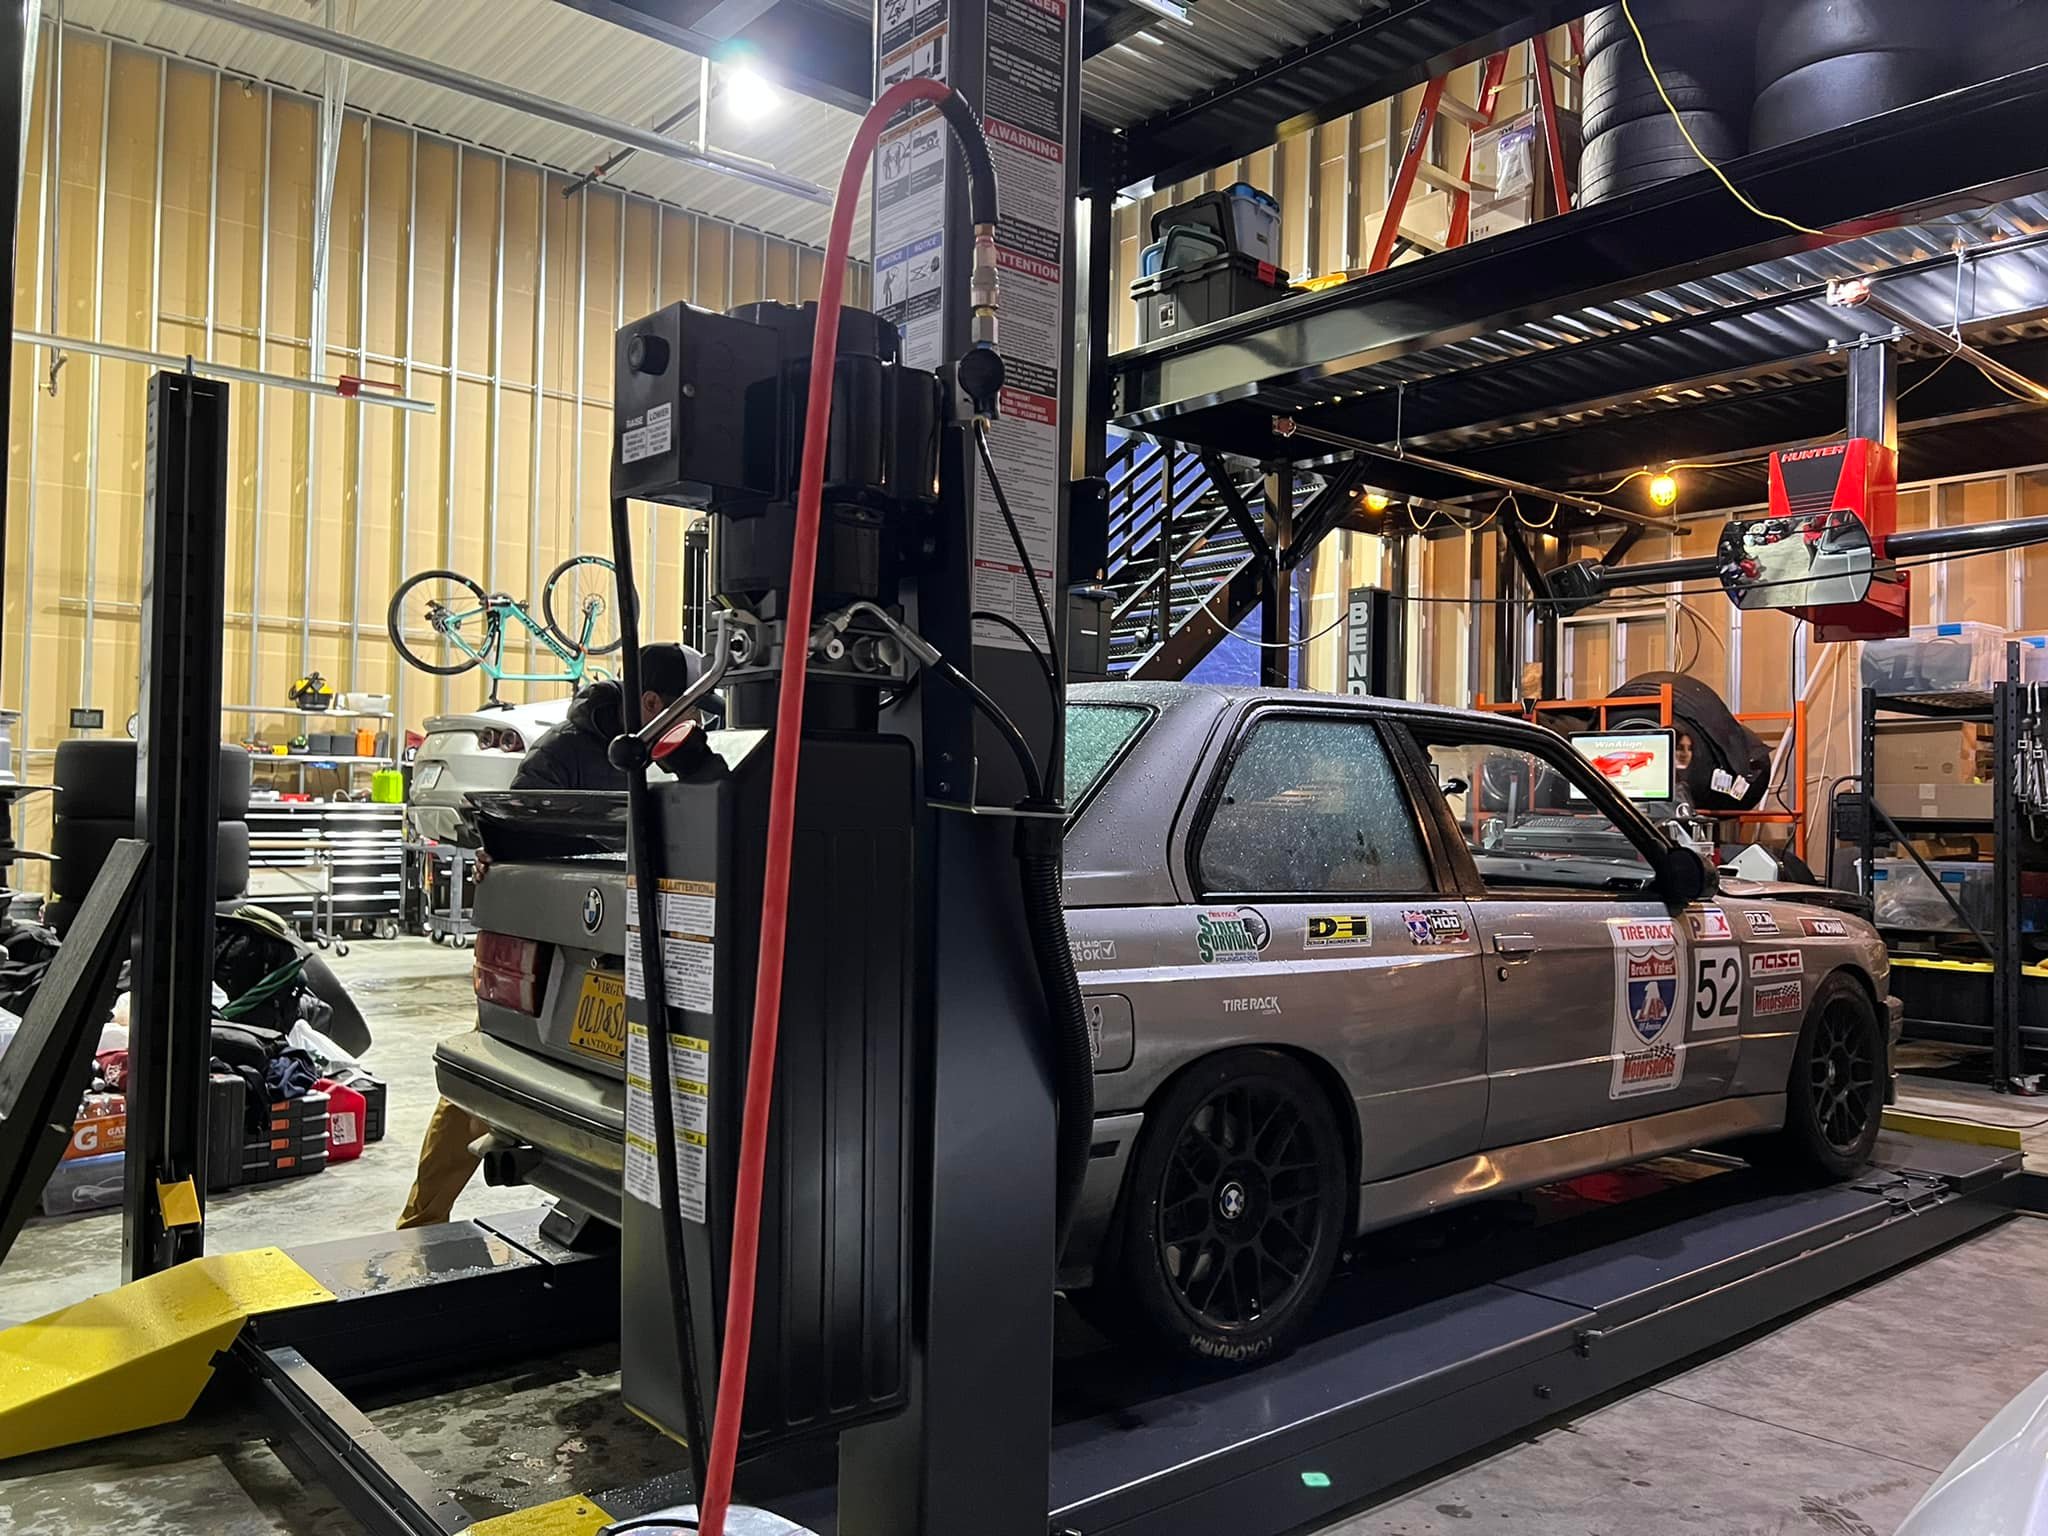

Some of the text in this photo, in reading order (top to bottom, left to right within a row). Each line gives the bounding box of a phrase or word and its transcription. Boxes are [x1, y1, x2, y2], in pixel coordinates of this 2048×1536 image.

[1000, 125, 1059, 158] WARNING
[1781, 446, 1845, 463] HUNTER
[1197, 914, 1246, 936] STREET
[1617, 925, 1679, 945] TIRE RACK
[1083, 949, 1100, 961] OK
[1198, 933, 1256, 962] SURVIVAL
[1630, 963, 1652, 976] Brock
[1696, 958, 1741, 1020] 52
[1223, 996, 1281, 1014] TIRE RACK
[74, 1124, 98, 1151] G
